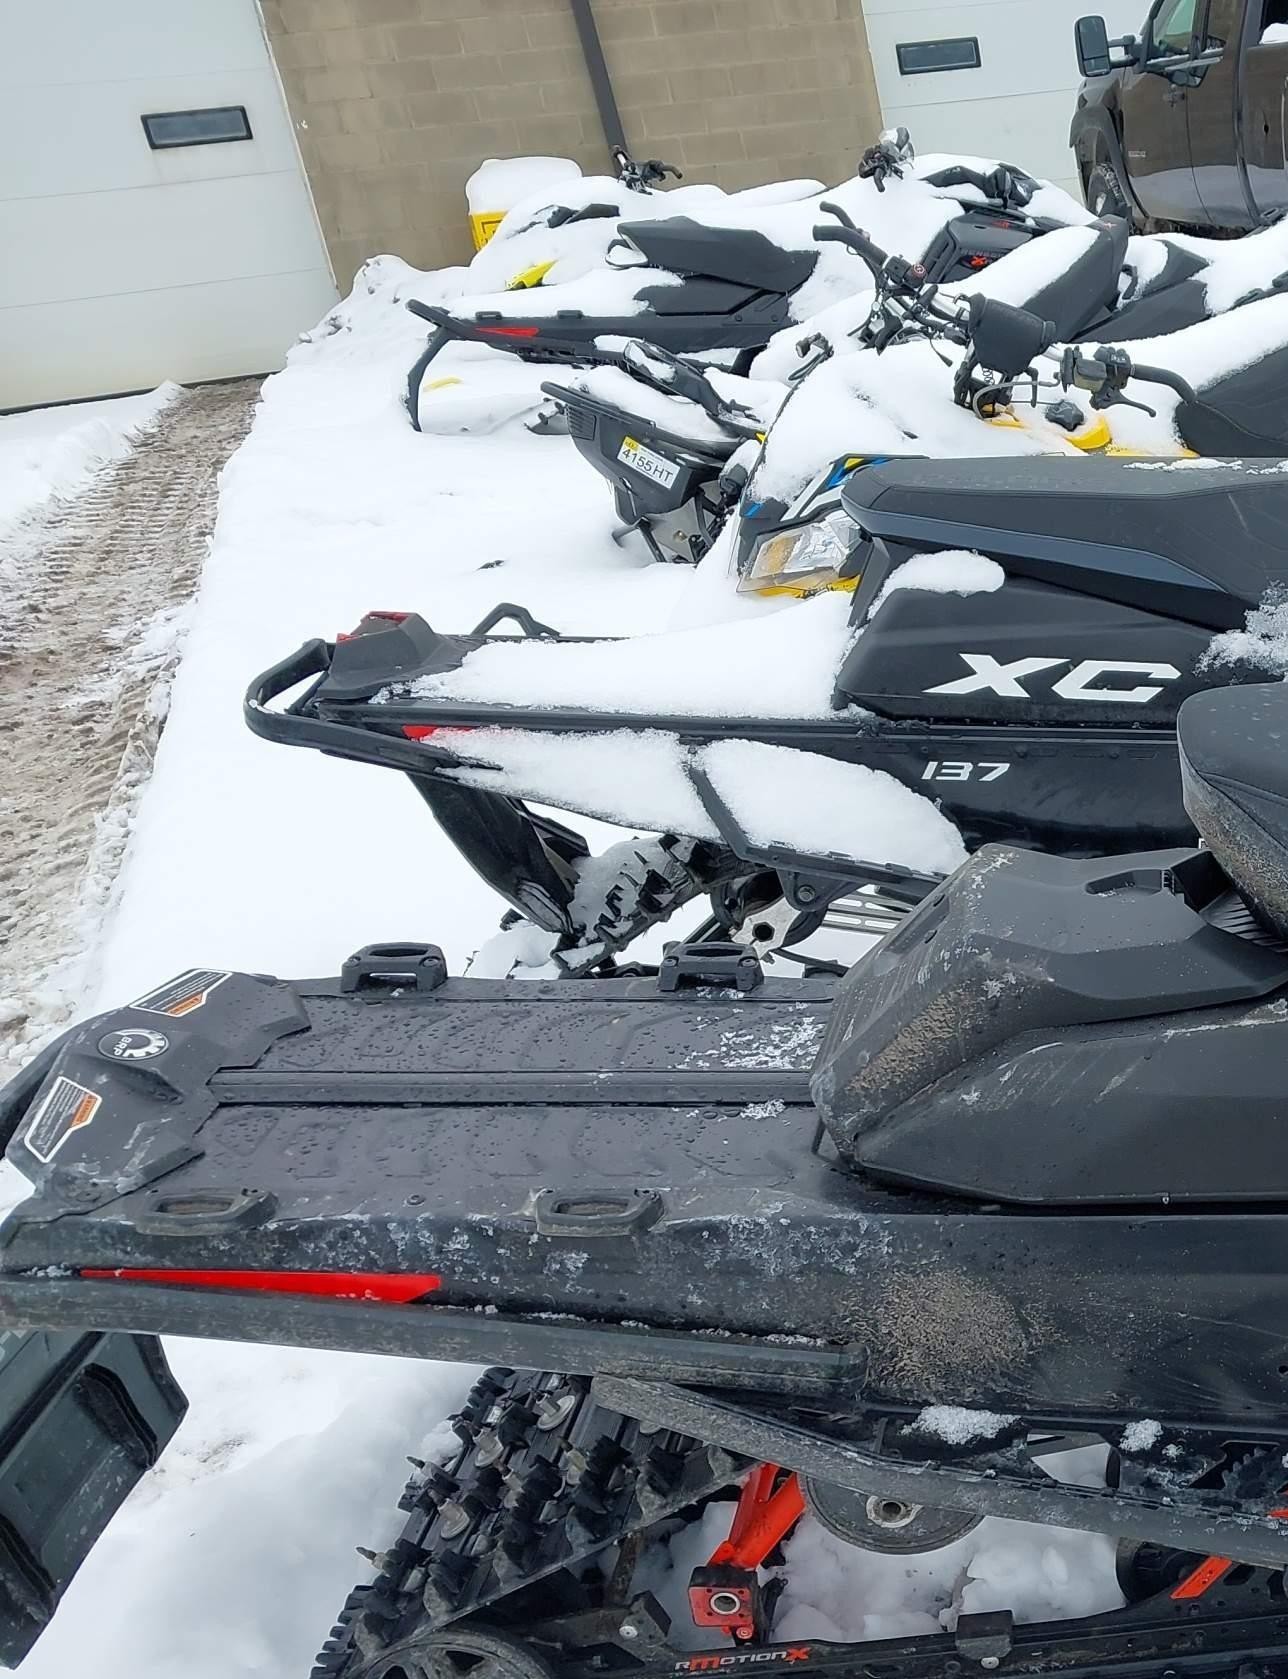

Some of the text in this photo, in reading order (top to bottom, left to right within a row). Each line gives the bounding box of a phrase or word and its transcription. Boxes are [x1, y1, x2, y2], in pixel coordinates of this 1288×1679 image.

[622, 448, 674, 482] 4155HT
[921, 653, 1182, 702] XC
[921, 761, 1010, 781] 137
[113, 1036, 132, 1056] BRP
